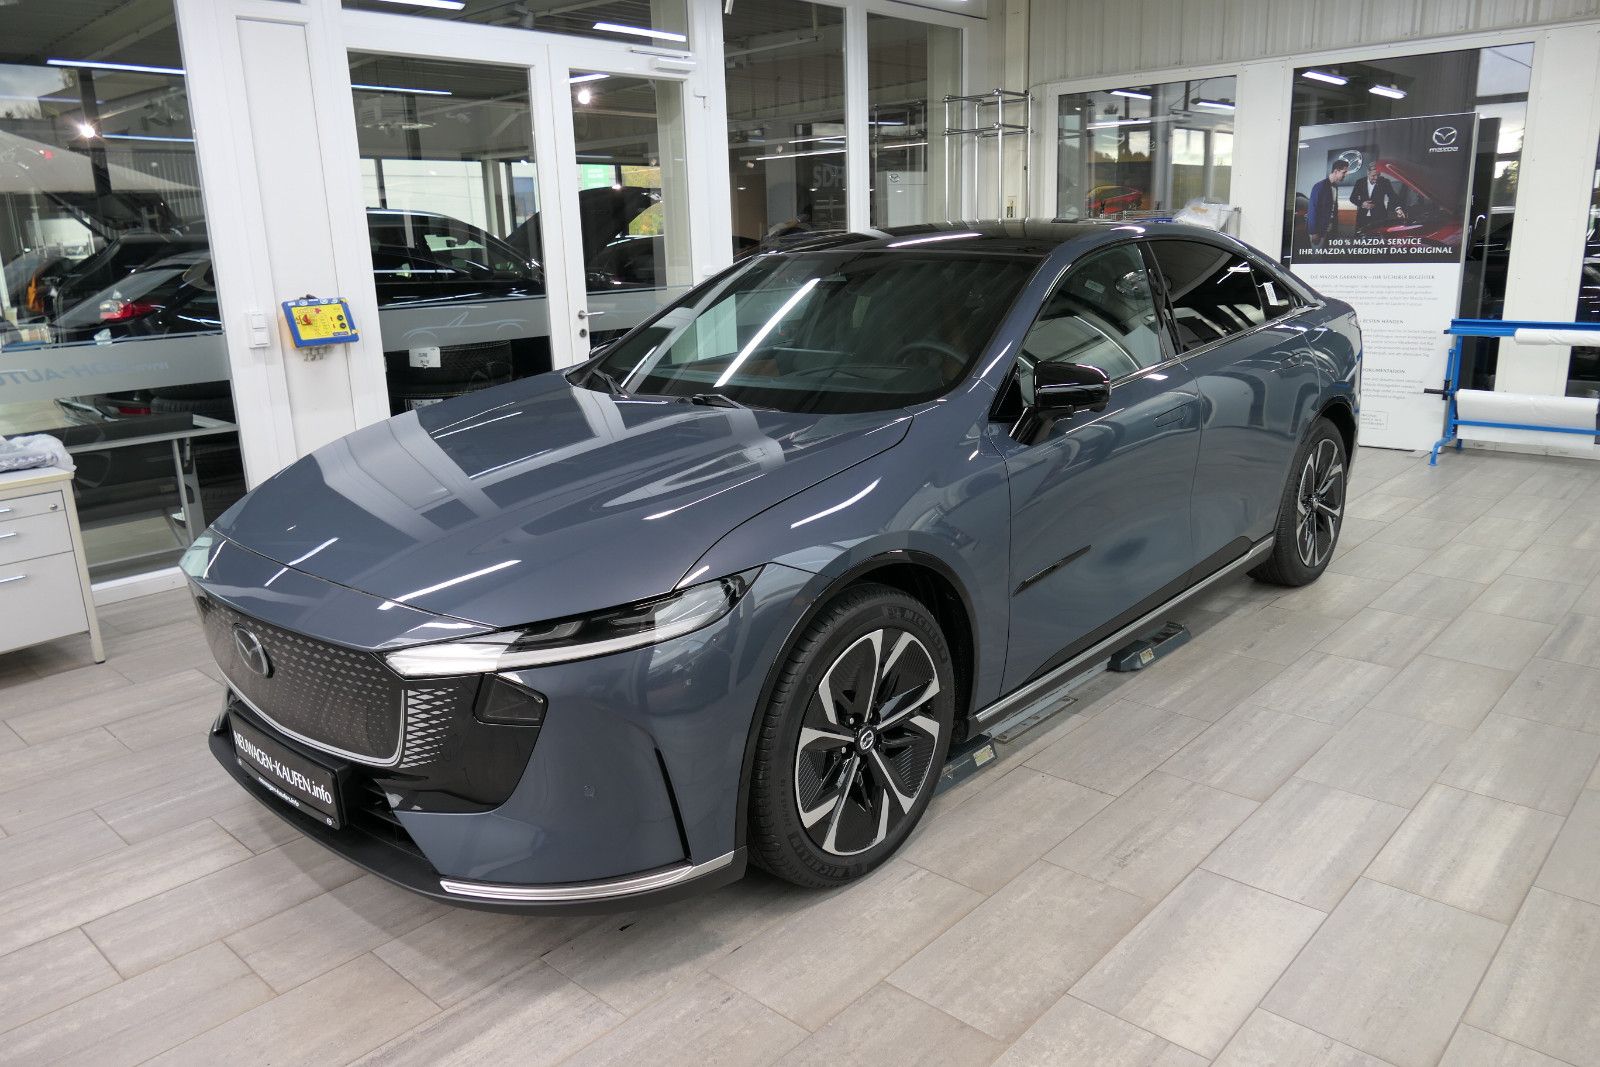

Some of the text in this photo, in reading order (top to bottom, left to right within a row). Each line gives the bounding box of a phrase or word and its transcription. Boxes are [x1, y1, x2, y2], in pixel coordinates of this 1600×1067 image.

[1353, 238, 1384, 246] MAZDA
[1387, 237, 1422, 245] SERVICE
[1315, 247, 1345, 255] MAZDA
[1347, 247, 1388, 255] VERDIENT
[1409, 246, 1453, 254] ORIGINAL
[232, 730, 333, 805] NEUWAGEN-KAUFEN.info
